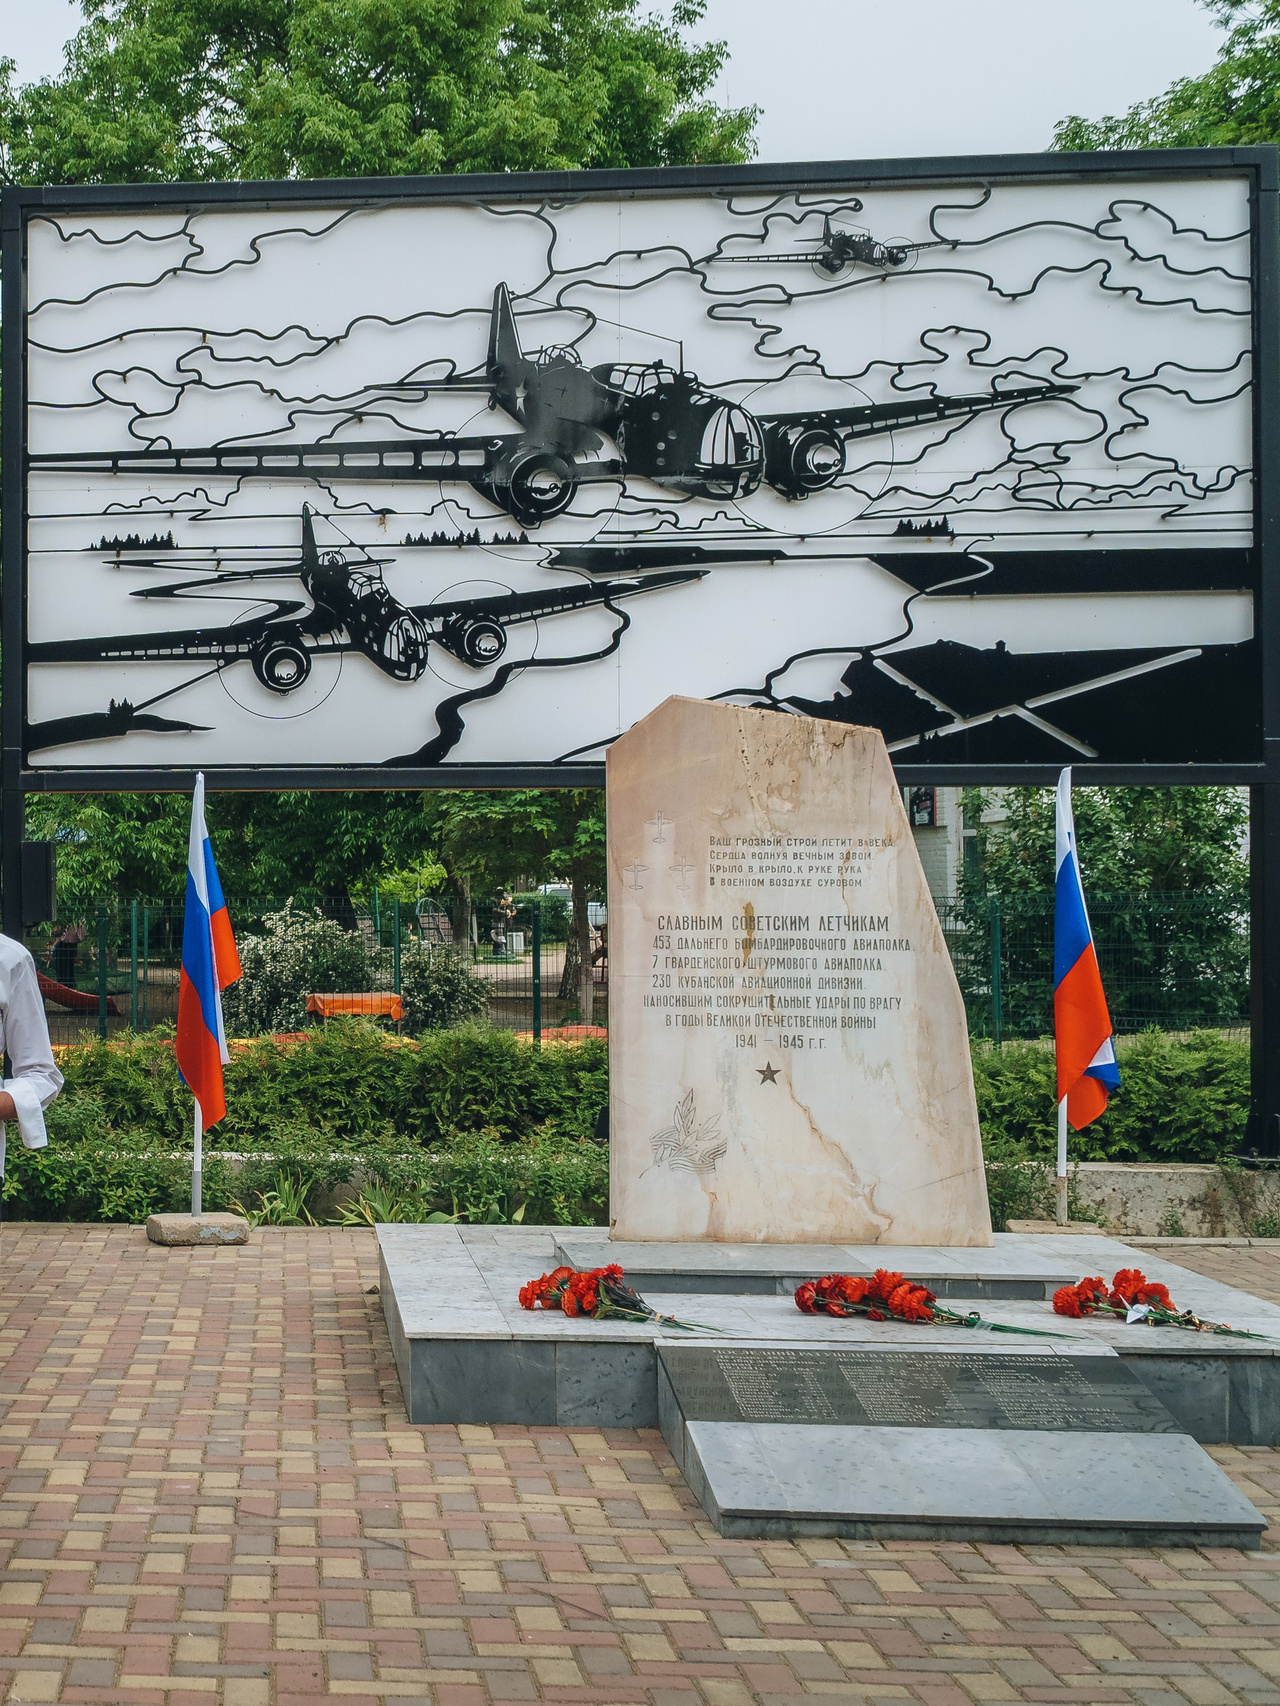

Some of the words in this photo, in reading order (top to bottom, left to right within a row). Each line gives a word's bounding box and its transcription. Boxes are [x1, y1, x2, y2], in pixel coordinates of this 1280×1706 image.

[822, 838, 852, 847] ЛЕТИТ
[858, 839, 863, 847] В
[751, 852, 788, 860] ВОЛНУЯ
[793, 852, 834, 861] ВЕЧНЫМ
[808, 866, 832, 874] РУКЕ
[837, 865, 862, 874] РУКА
[720, 879, 765, 887] ВОЕННОМ
[770, 879, 812, 888] ВОЗДУХЕ
[658, 915, 723, 931] СЛАВНЫМ
[732, 915, 810, 931] СОВЕТСКИМ
[819, 916, 889, 932] ЛЕТЧИКАМ
[652, 935, 671, 950] 453
[677, 937, 728, 951] ДАЛЬНЕГО
[735, 937, 846, 951] БОМБАРДИРОВОЧНОГО
[652, 954, 659, 969] 7
[747, 957, 818, 970] ШТУРМОВОГО
[652, 973, 671, 988] 230
[678, 974, 735, 989] КУБАНСКОЙ
[741, 974, 812, 990] АВИАЦИОННОЙ
[643, 995, 713, 1008] НАНОСИВШИМ
[716, 994, 812, 1010] СОКРУШИТЕЛЬНЫЕ
[815, 996, 850, 1009] УДАРЫ
[853, 996, 866, 1009] ПО
[869, 997, 902, 1010] ВРАГУ
[665, 1014, 672, 1026] В
[675, 1014, 704, 1027] ГОДЫ
[841, 1014, 876, 1029] ВОЙНЫ
[735, 1034, 757, 1048] 1941
[779, 1034, 804, 1049] 1945
